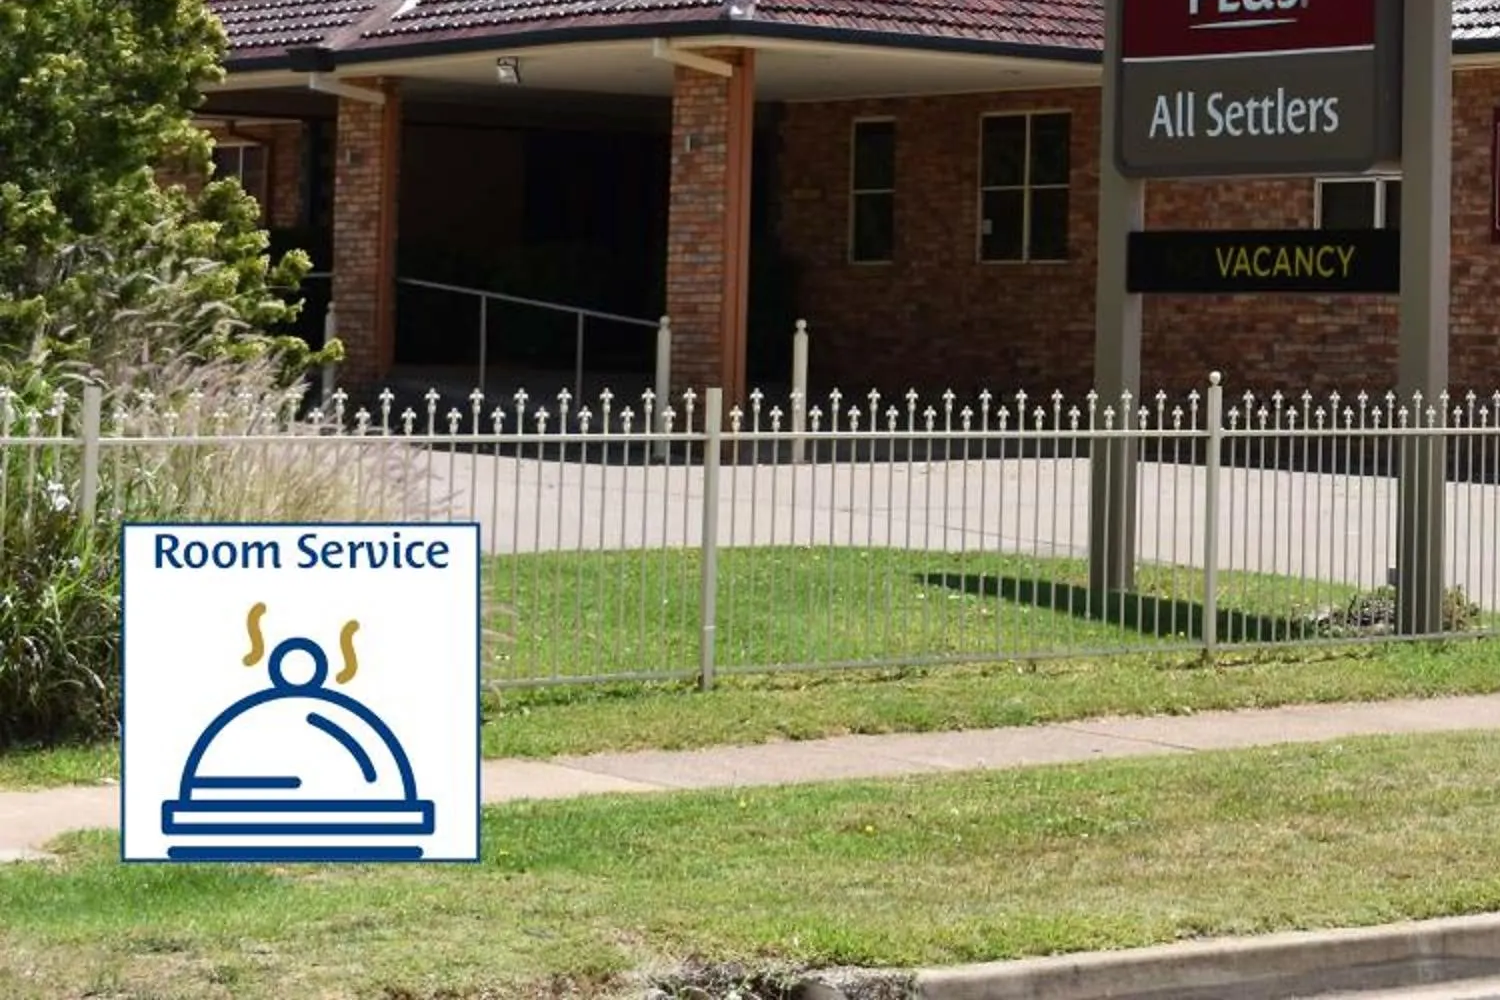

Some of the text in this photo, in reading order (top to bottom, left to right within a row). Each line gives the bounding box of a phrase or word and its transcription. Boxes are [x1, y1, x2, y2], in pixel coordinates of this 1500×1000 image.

[1149, 87, 1340, 139] All Settlers
[1215, 245, 1355, 278] VACANCY
